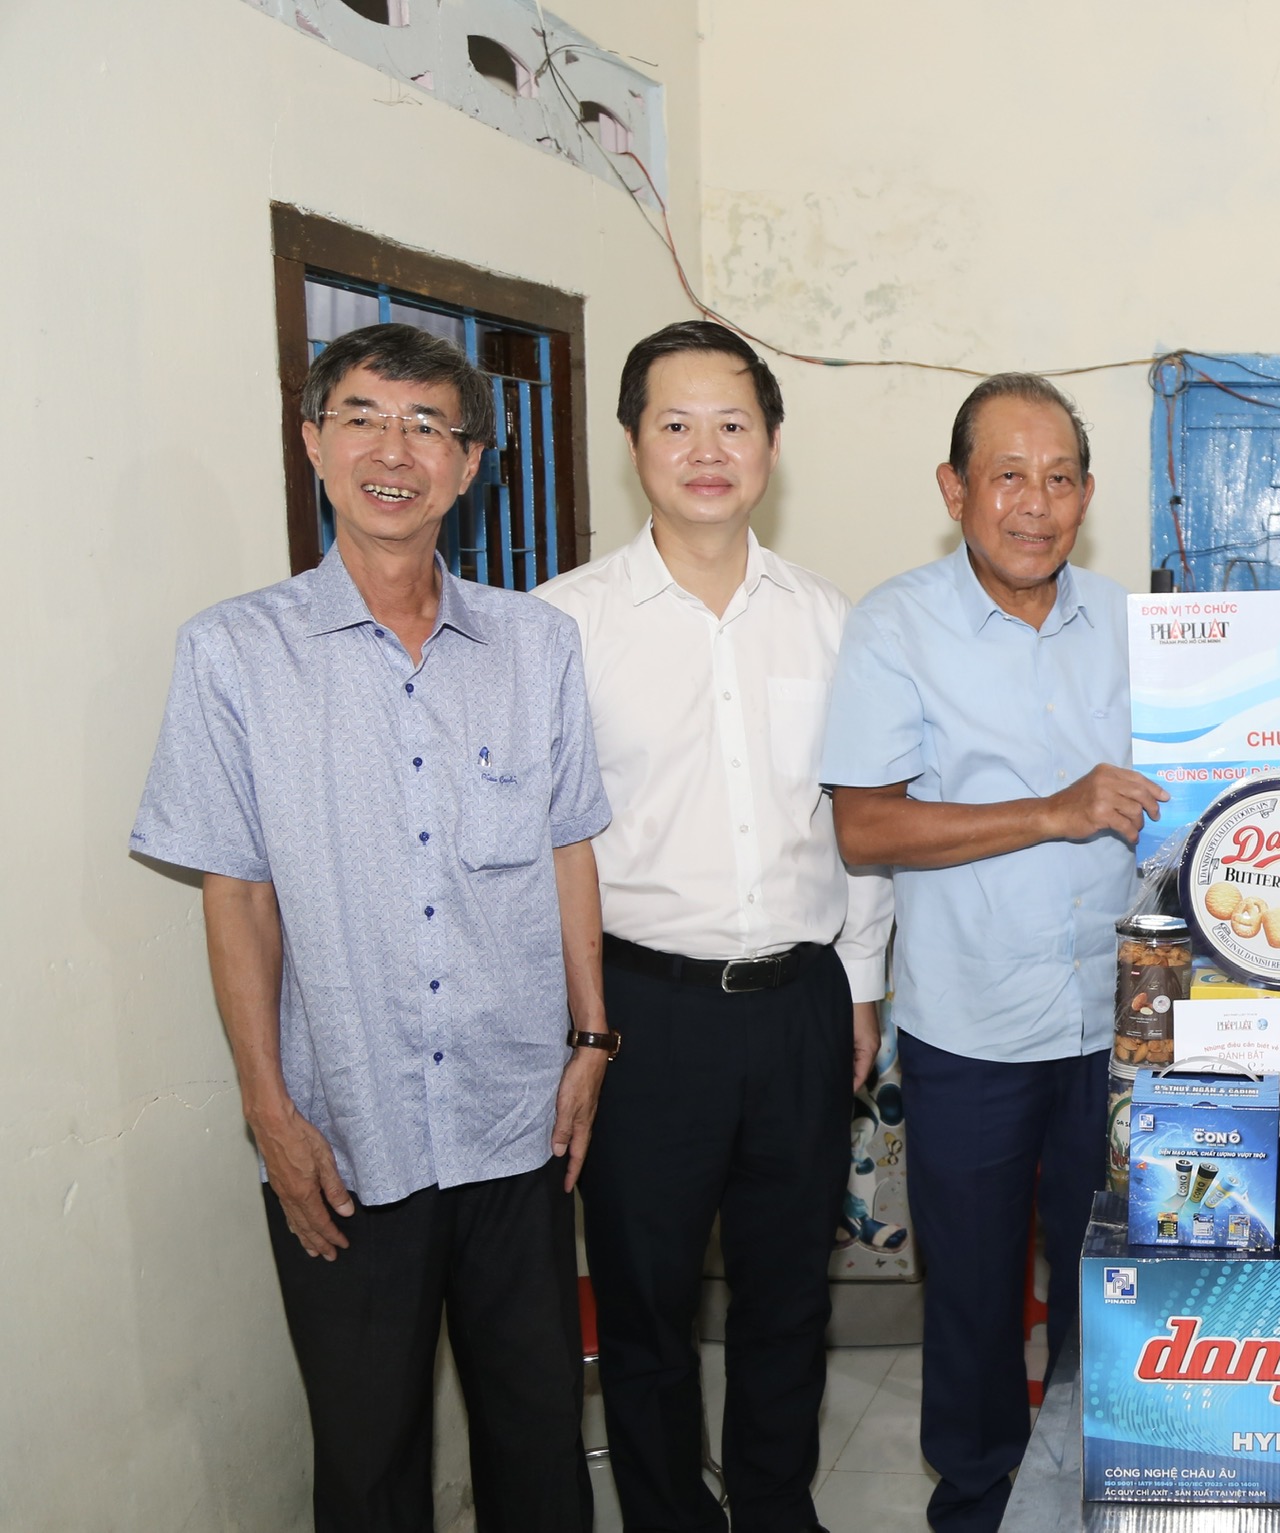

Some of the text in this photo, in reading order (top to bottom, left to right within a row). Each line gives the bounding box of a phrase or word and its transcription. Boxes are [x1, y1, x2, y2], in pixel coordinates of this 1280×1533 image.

[1141, 605, 1168, 616] ĐƠN
[1170, 605, 1182, 617] VỊ
[1203, 601, 1238, 614] CHỨC
[1224, 867, 1280, 889] BUTTER
[1217, 930, 1244, 955] ORIGINAL
[1245, 952, 1271, 968] DANISH
[1104, 1466, 1236, 1480] CÔNG NGHỆ CHÂU ÂU
[1117, 1489, 1135, 1497] QUY
[1192, 1488, 1214, 1497] XUẤT
[1214, 1490, 1229, 1498] TẠI
[1229, 1490, 1246, 1498] VIỆT
